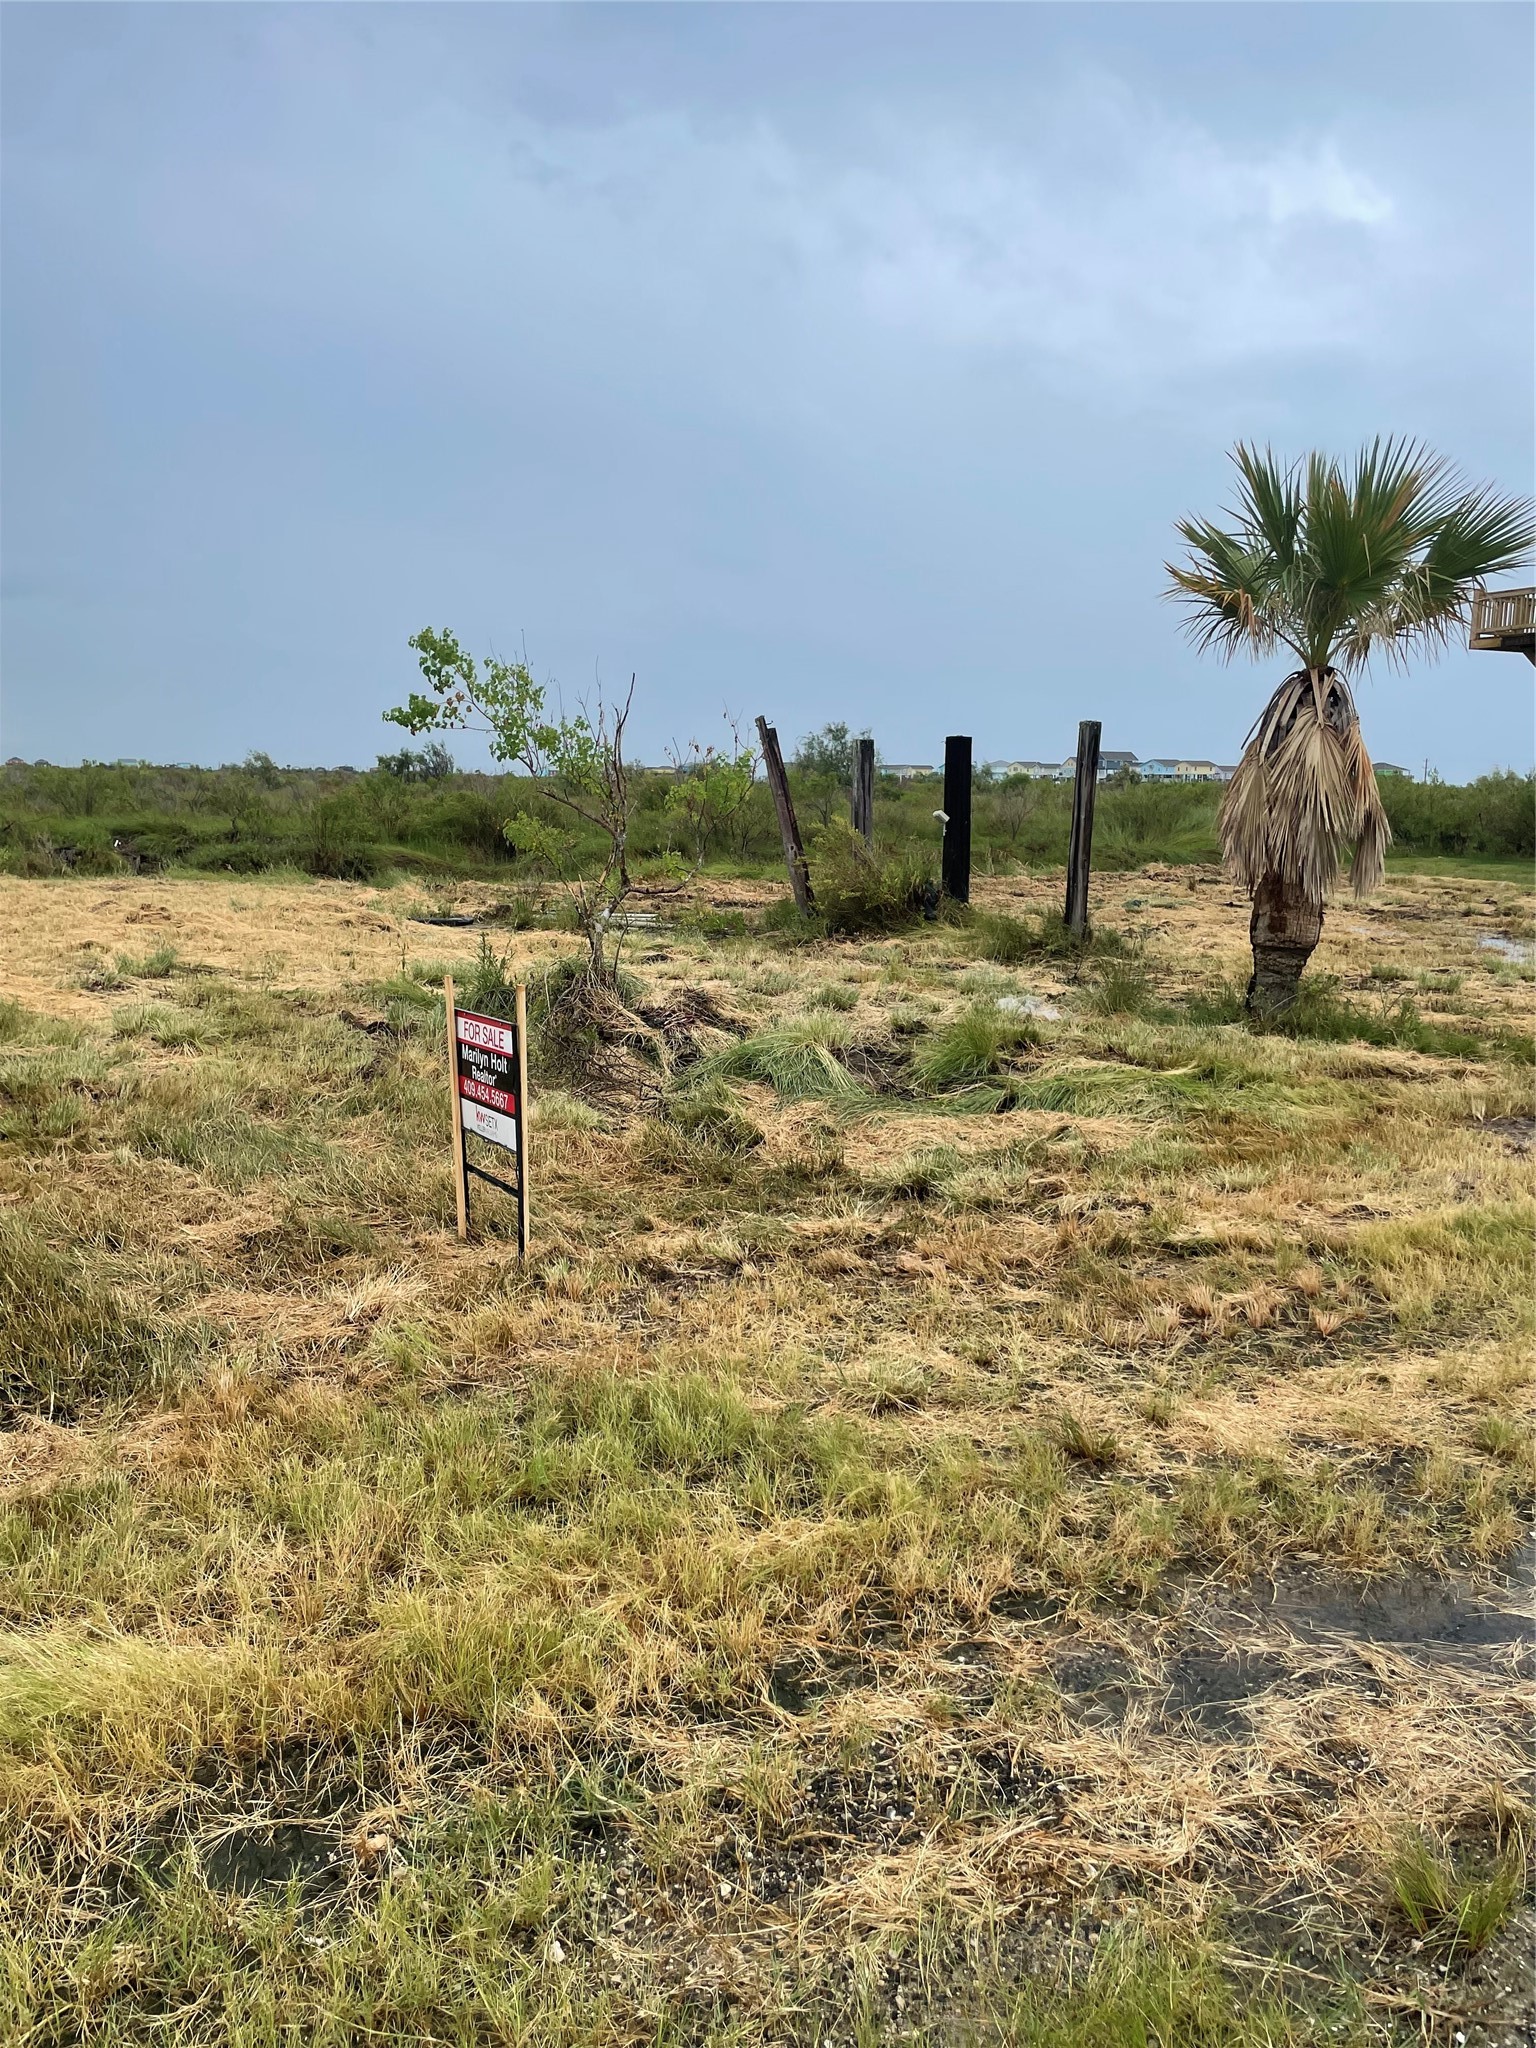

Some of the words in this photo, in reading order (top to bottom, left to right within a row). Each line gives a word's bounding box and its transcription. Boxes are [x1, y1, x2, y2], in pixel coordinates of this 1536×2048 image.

[464, 1021, 481, 1042] FOR
[483, 1026, 504, 1049] SALE
[462, 1043, 489, 1069] Marilyn
[490, 1053, 507, 1074] Holt
[463, 1079, 508, 1109] 409.454.5667
